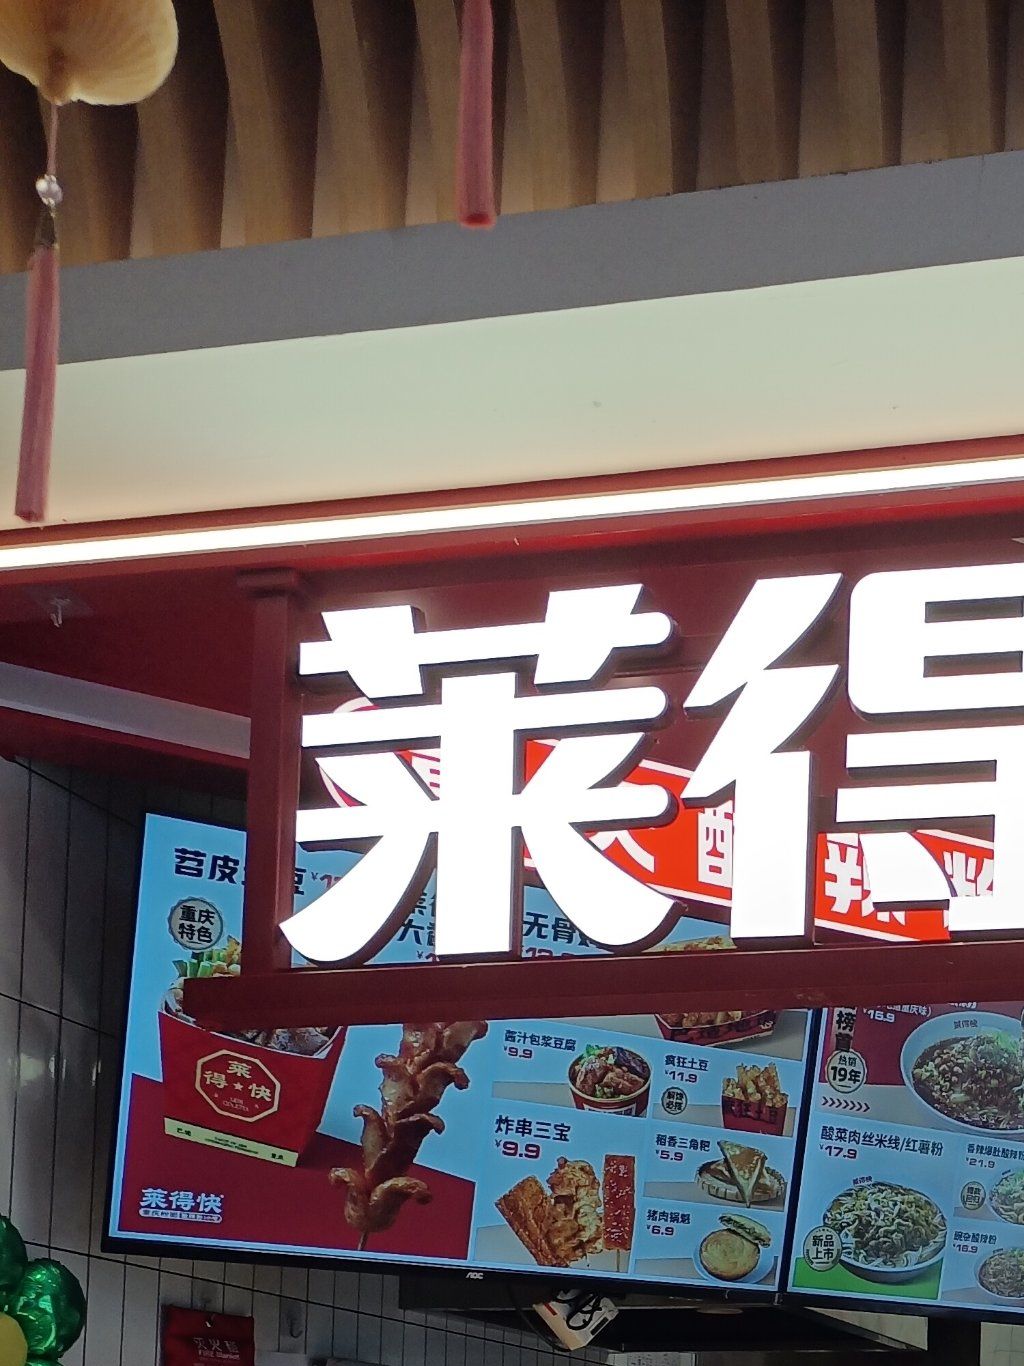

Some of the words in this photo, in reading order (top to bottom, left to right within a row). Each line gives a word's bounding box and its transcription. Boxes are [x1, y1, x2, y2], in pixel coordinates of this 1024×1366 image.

[180, 904, 214, 926] 重庆
[178, 922, 212, 943] 特色
[503, 1046, 533, 1059] ¥9.9
[665, 1054, 709, 1071] 疯狂土豆
[665, 1070, 698, 1083] ¥11.9
[830, 1066, 862, 1084] 19年
[494, 1115, 572, 1142] 炸串三宝
[495, 1139, 541, 1159] ¥9.9
[140, 1187, 224, 1215] 莱得快
[646, 1224, 674, 1237] ¥6.9
[812, 1235, 835, 1248] 新品
[812, 1247, 835, 1260] 上市
